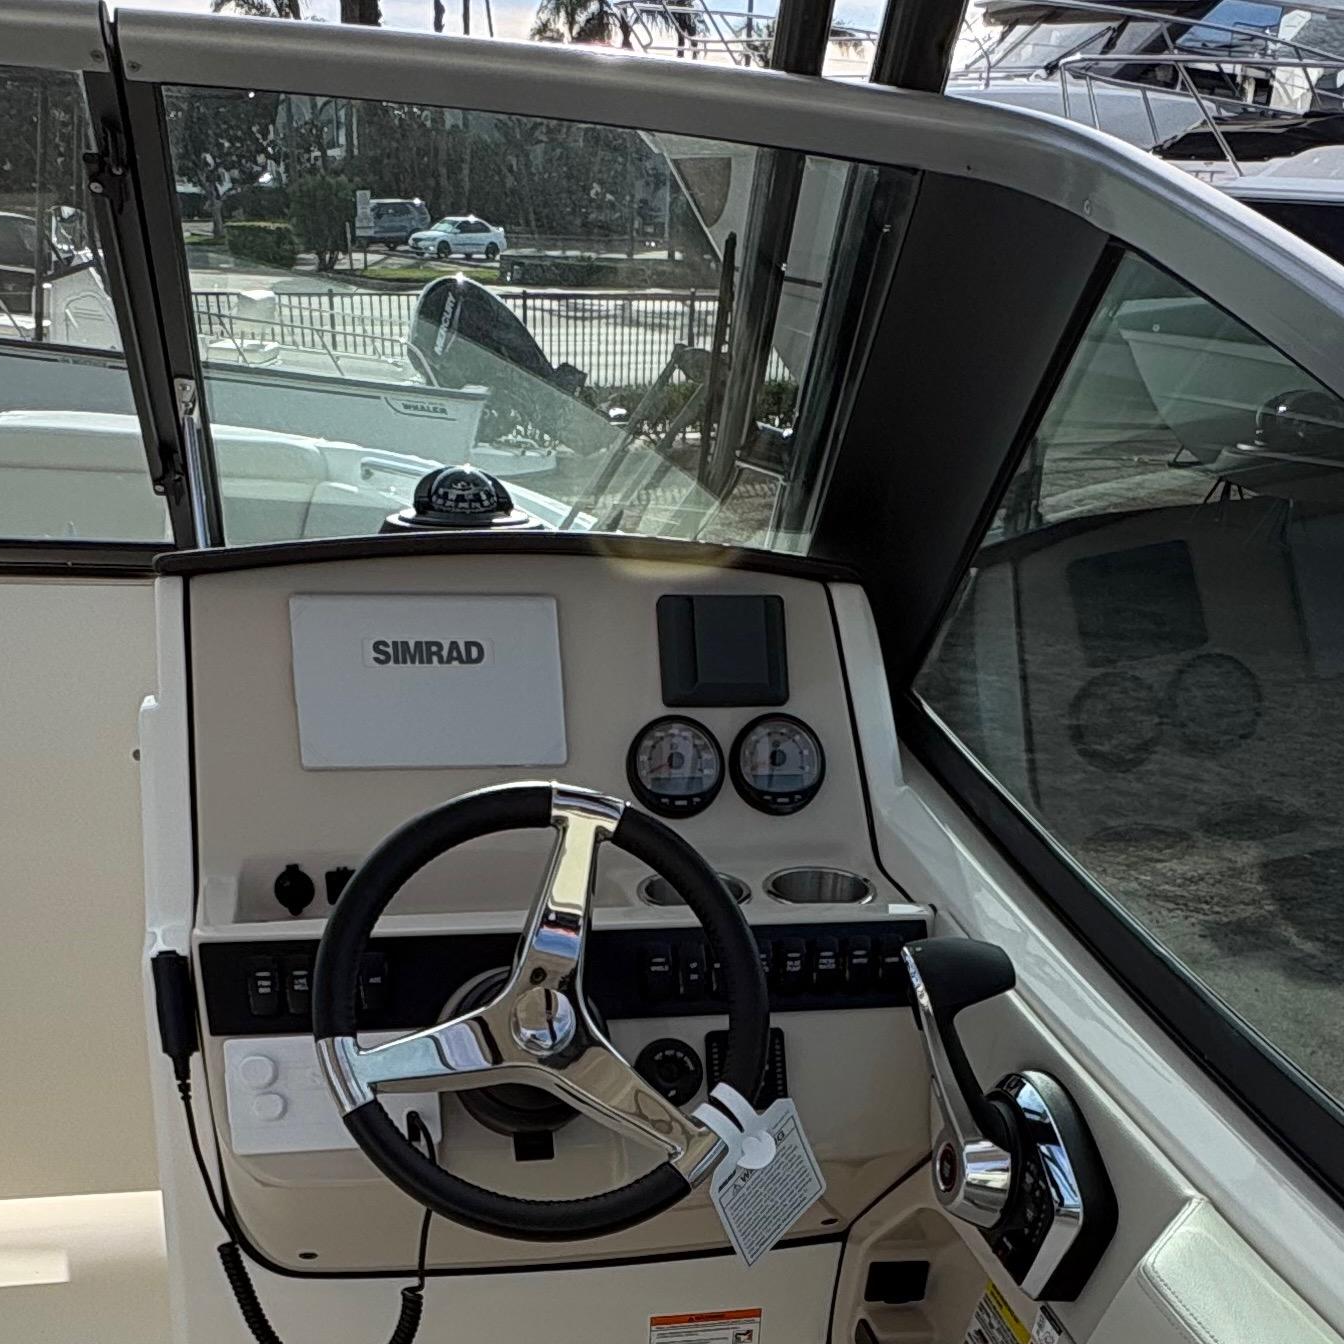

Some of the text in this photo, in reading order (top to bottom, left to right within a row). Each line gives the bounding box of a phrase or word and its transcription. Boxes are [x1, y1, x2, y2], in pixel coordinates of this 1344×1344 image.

[434, 291, 456, 356] MERCURY
[401, 402, 449, 416] WHALER
[372, 640, 485, 665] SIMRAD
